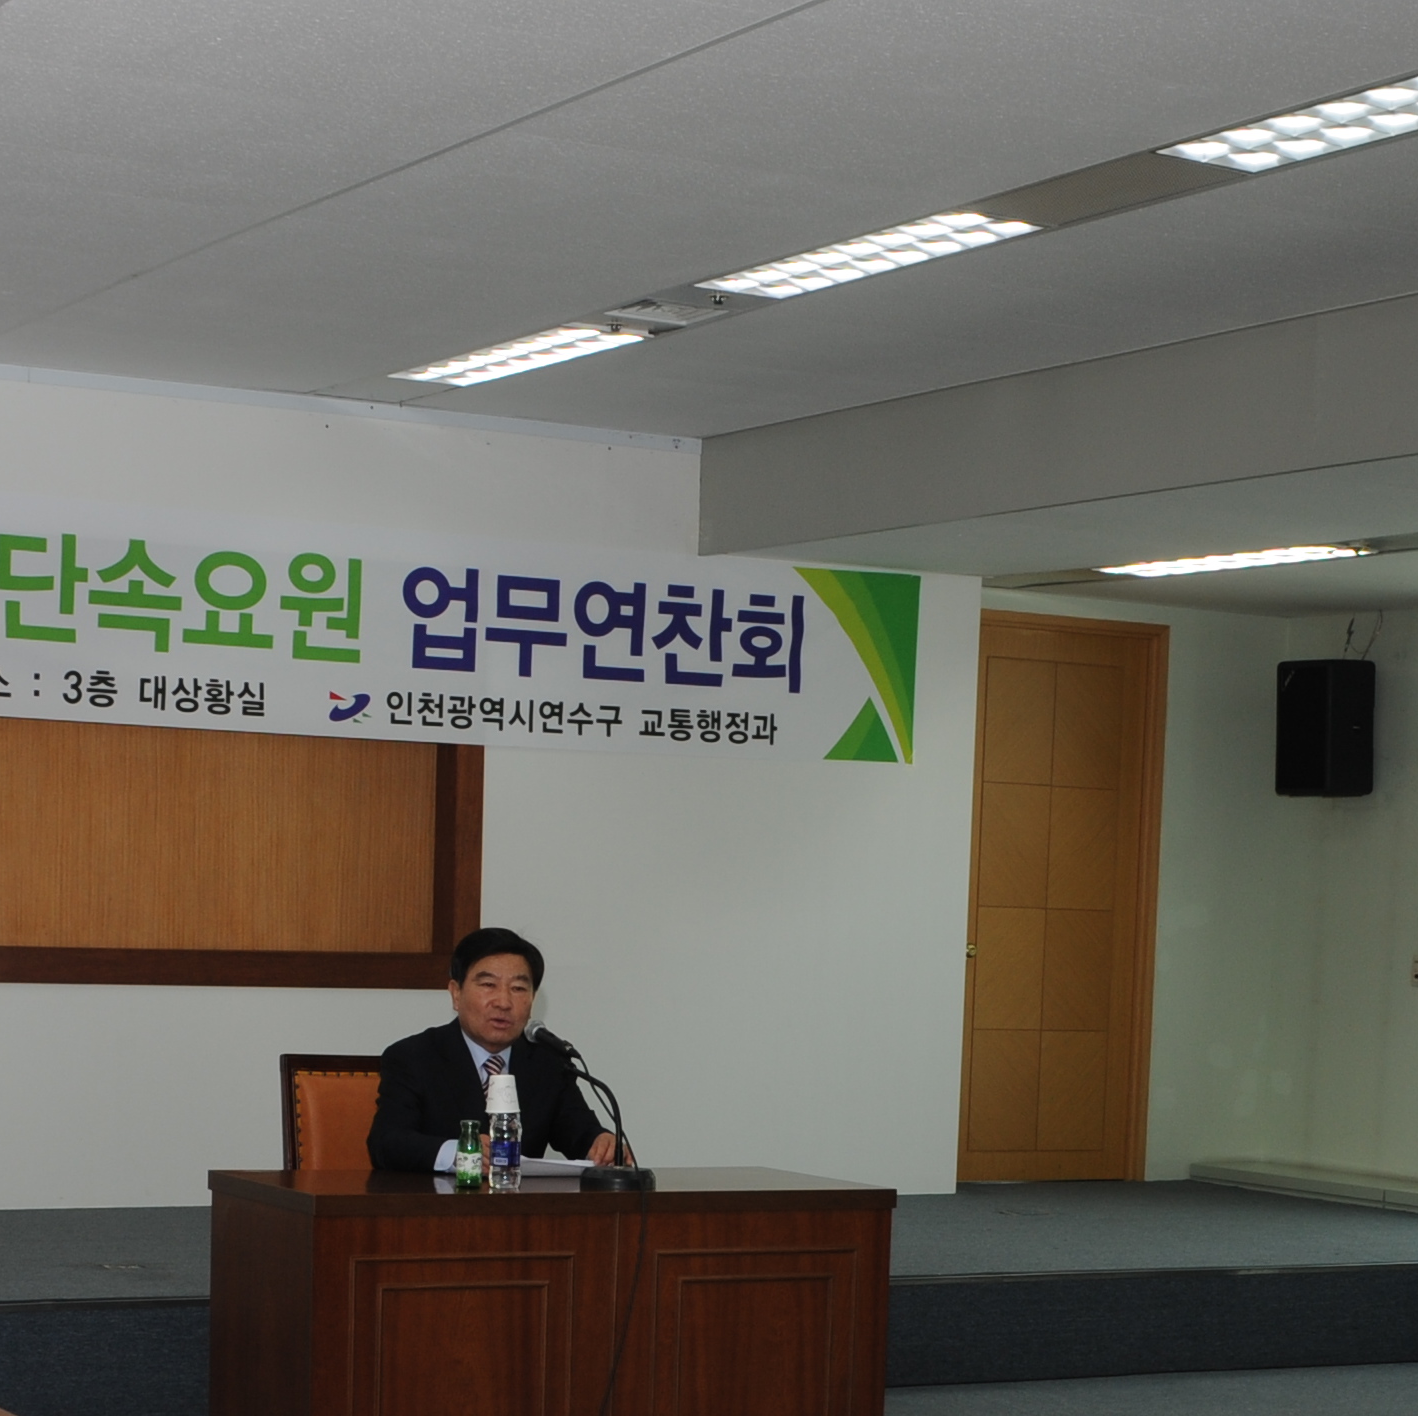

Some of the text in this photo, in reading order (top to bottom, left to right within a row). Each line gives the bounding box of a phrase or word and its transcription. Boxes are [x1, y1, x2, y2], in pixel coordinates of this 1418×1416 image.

[402, 566, 806, 694] 업무연찬회
[62, 671, 118, 708] 3층
[139, 676, 265, 717] 대상황실
[384, 691, 778, 746] 인천광역시연수구 교통행정과
